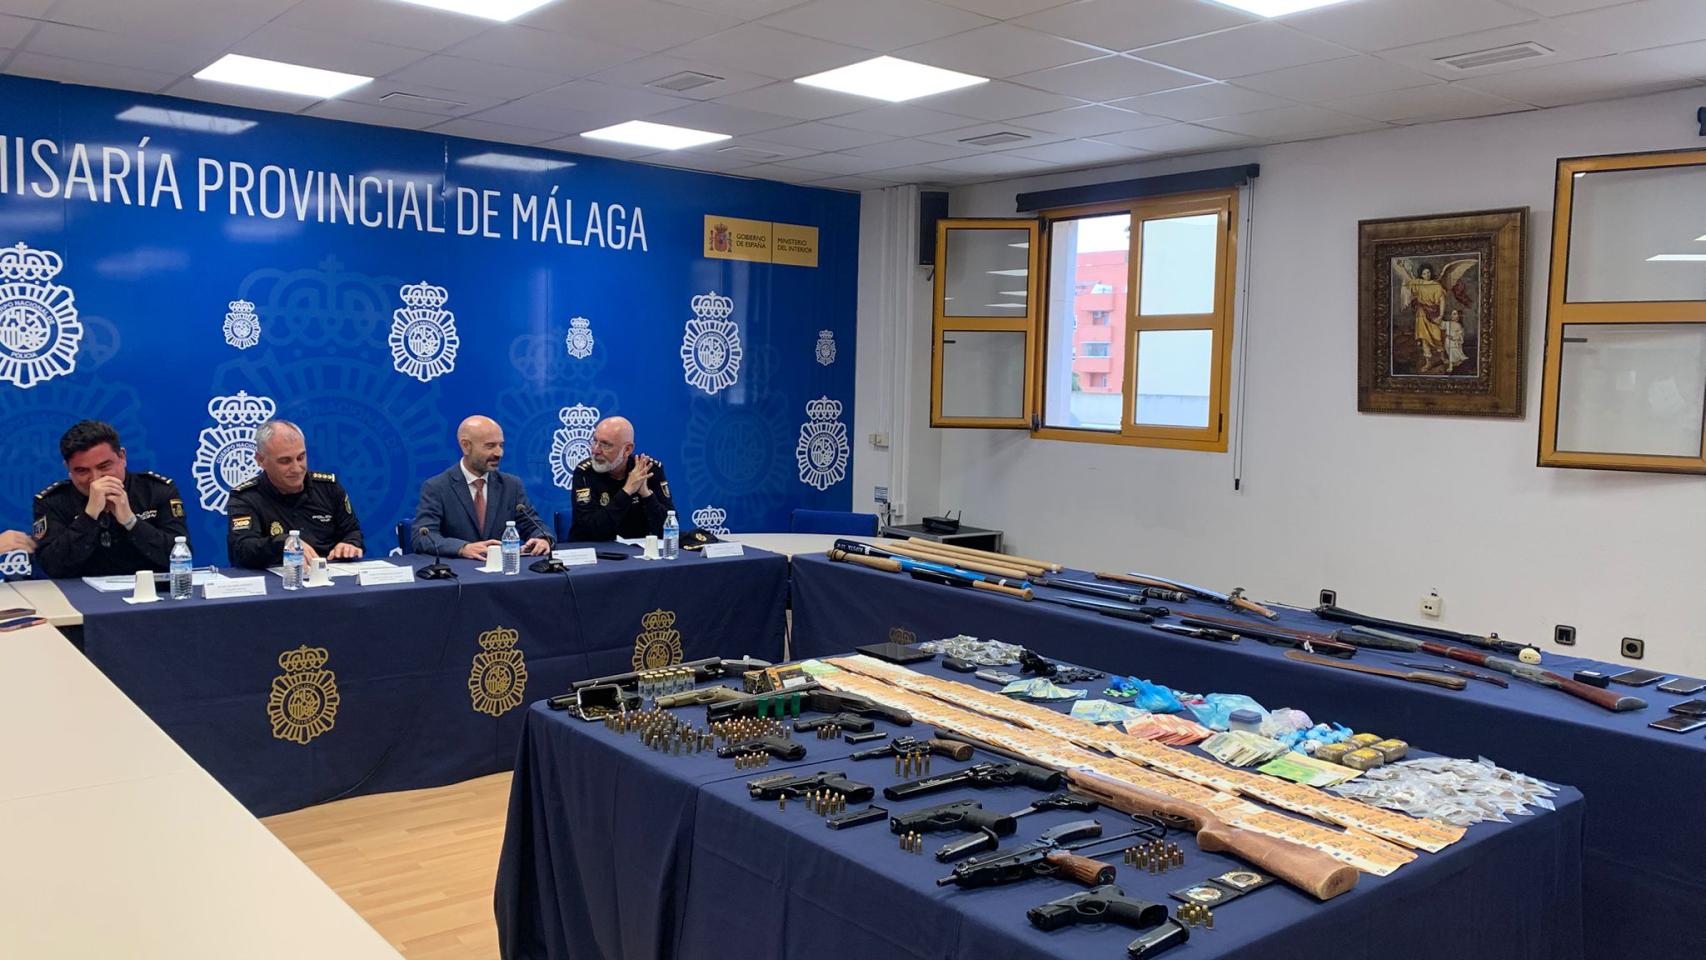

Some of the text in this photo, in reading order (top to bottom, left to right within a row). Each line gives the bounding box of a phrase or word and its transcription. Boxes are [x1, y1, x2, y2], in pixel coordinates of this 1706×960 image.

[0, 135, 648, 252] ISARÍA PROVINCIAL DE MÁLAGA
[736, 233, 766, 241] GOBIERNO
[745, 241, 766, 249] ESPAÑA
[777, 238, 807, 246] MINISTERIO
[788, 246, 812, 254] INTERIOR
